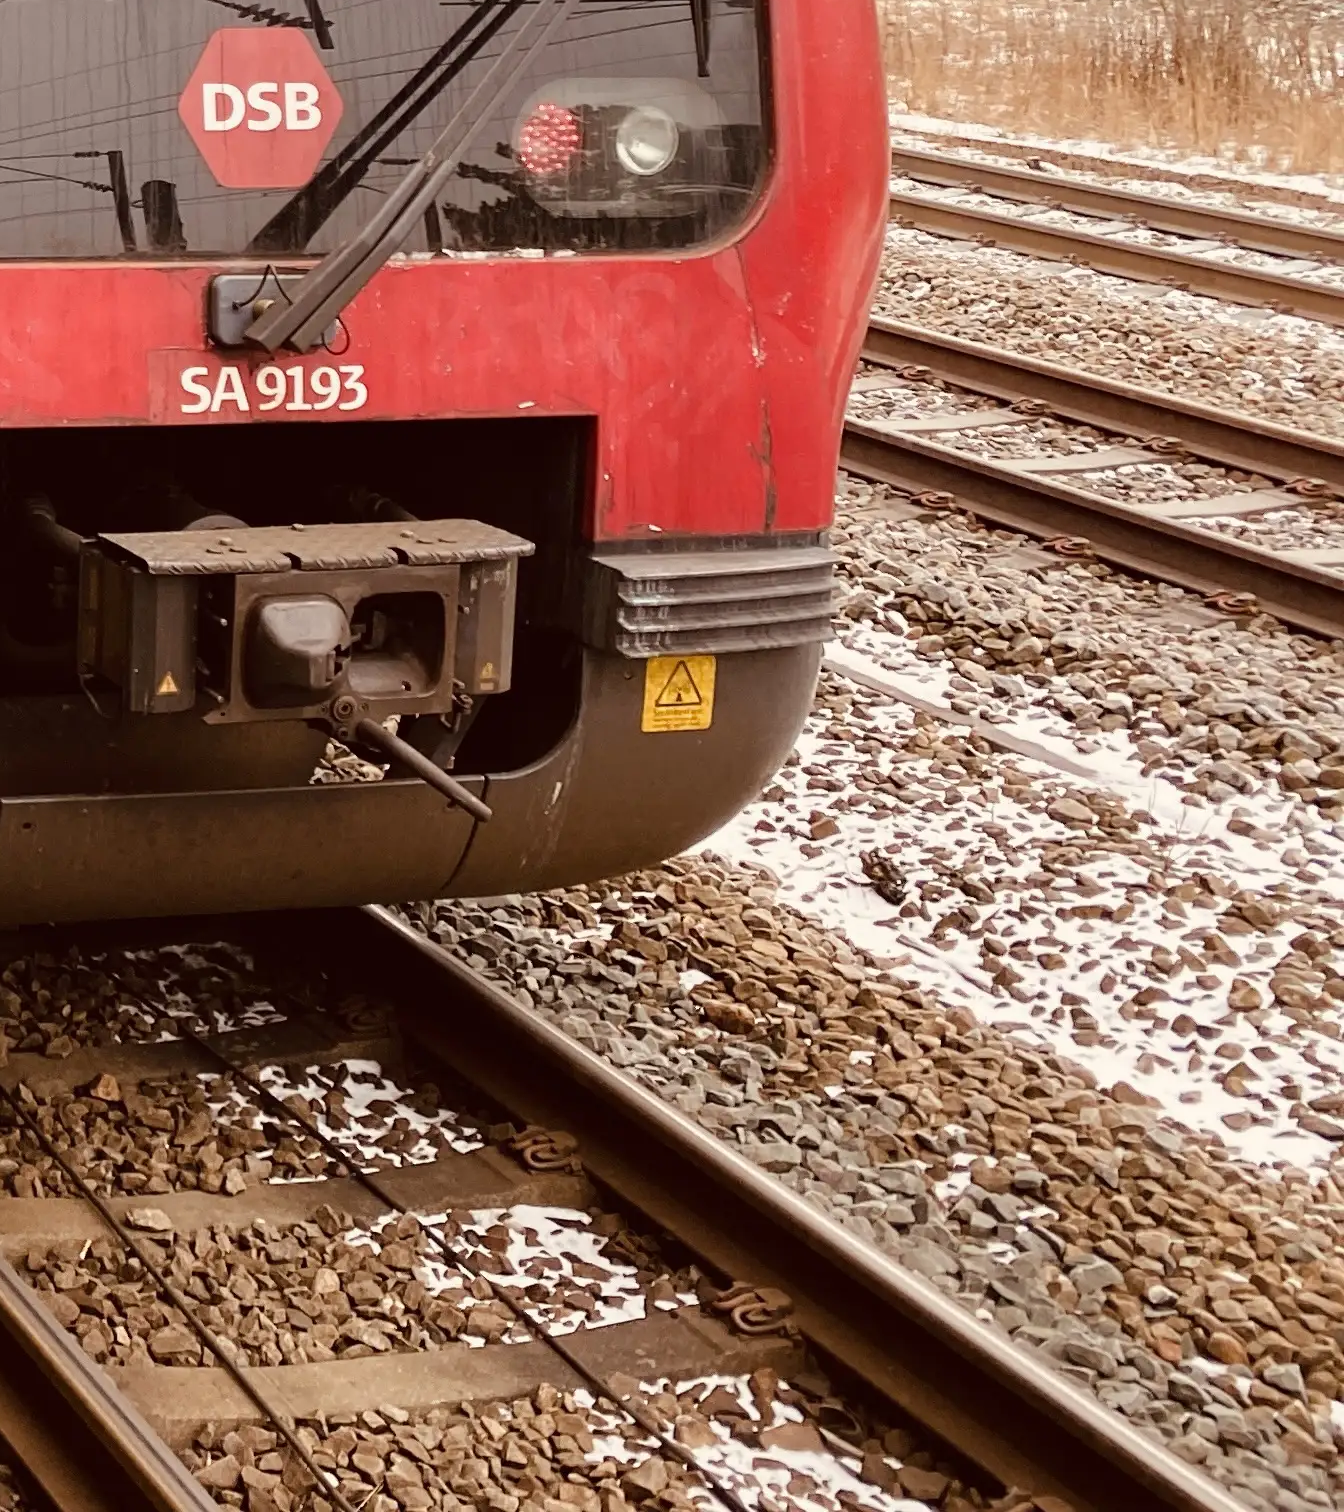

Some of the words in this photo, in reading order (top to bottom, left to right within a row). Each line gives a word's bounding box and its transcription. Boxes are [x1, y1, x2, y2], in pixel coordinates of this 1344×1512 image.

[202, 82, 323, 132] DSB
[180, 365, 250, 414] SA
[256, 364, 368, 413] 9193
